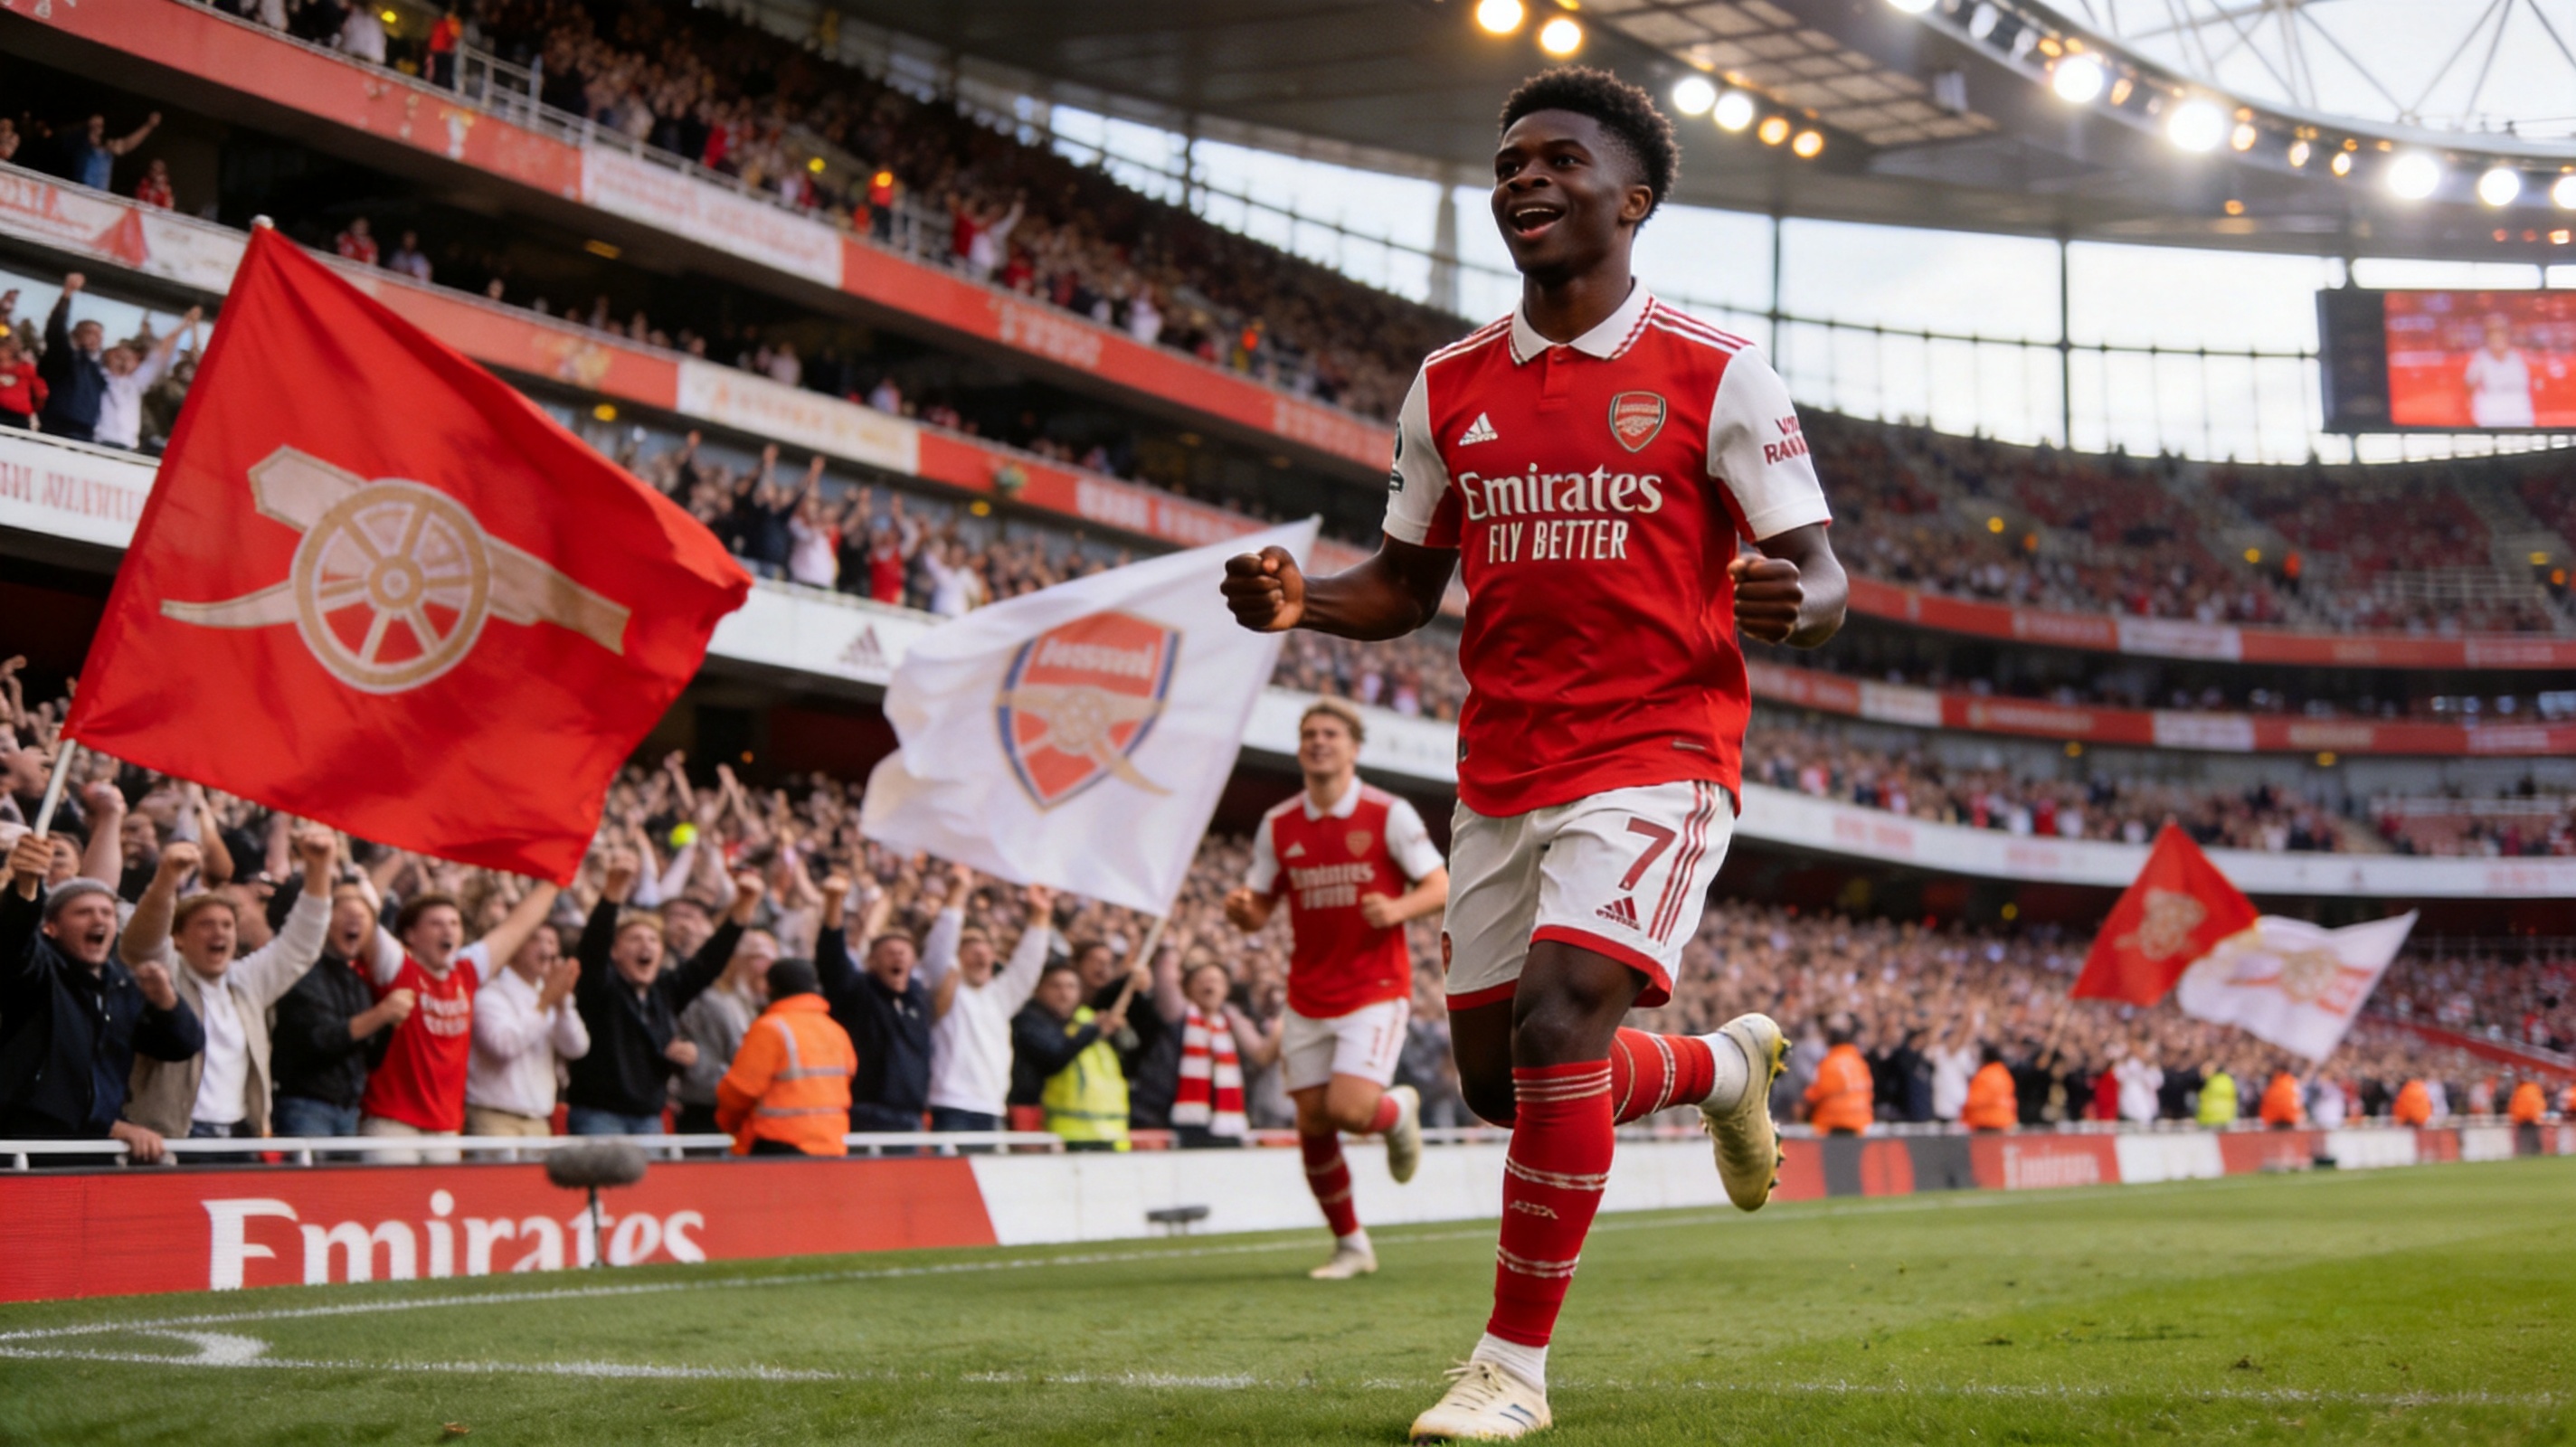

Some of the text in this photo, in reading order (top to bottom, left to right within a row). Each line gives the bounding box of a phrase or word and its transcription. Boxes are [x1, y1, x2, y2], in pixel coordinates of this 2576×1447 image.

[1457, 462, 1663, 522] Emirates
[1488, 518, 1629, 564] FLY BETTER
[1616, 816, 1678, 892] 7
[200, 1188, 706, 1291] Emirates
